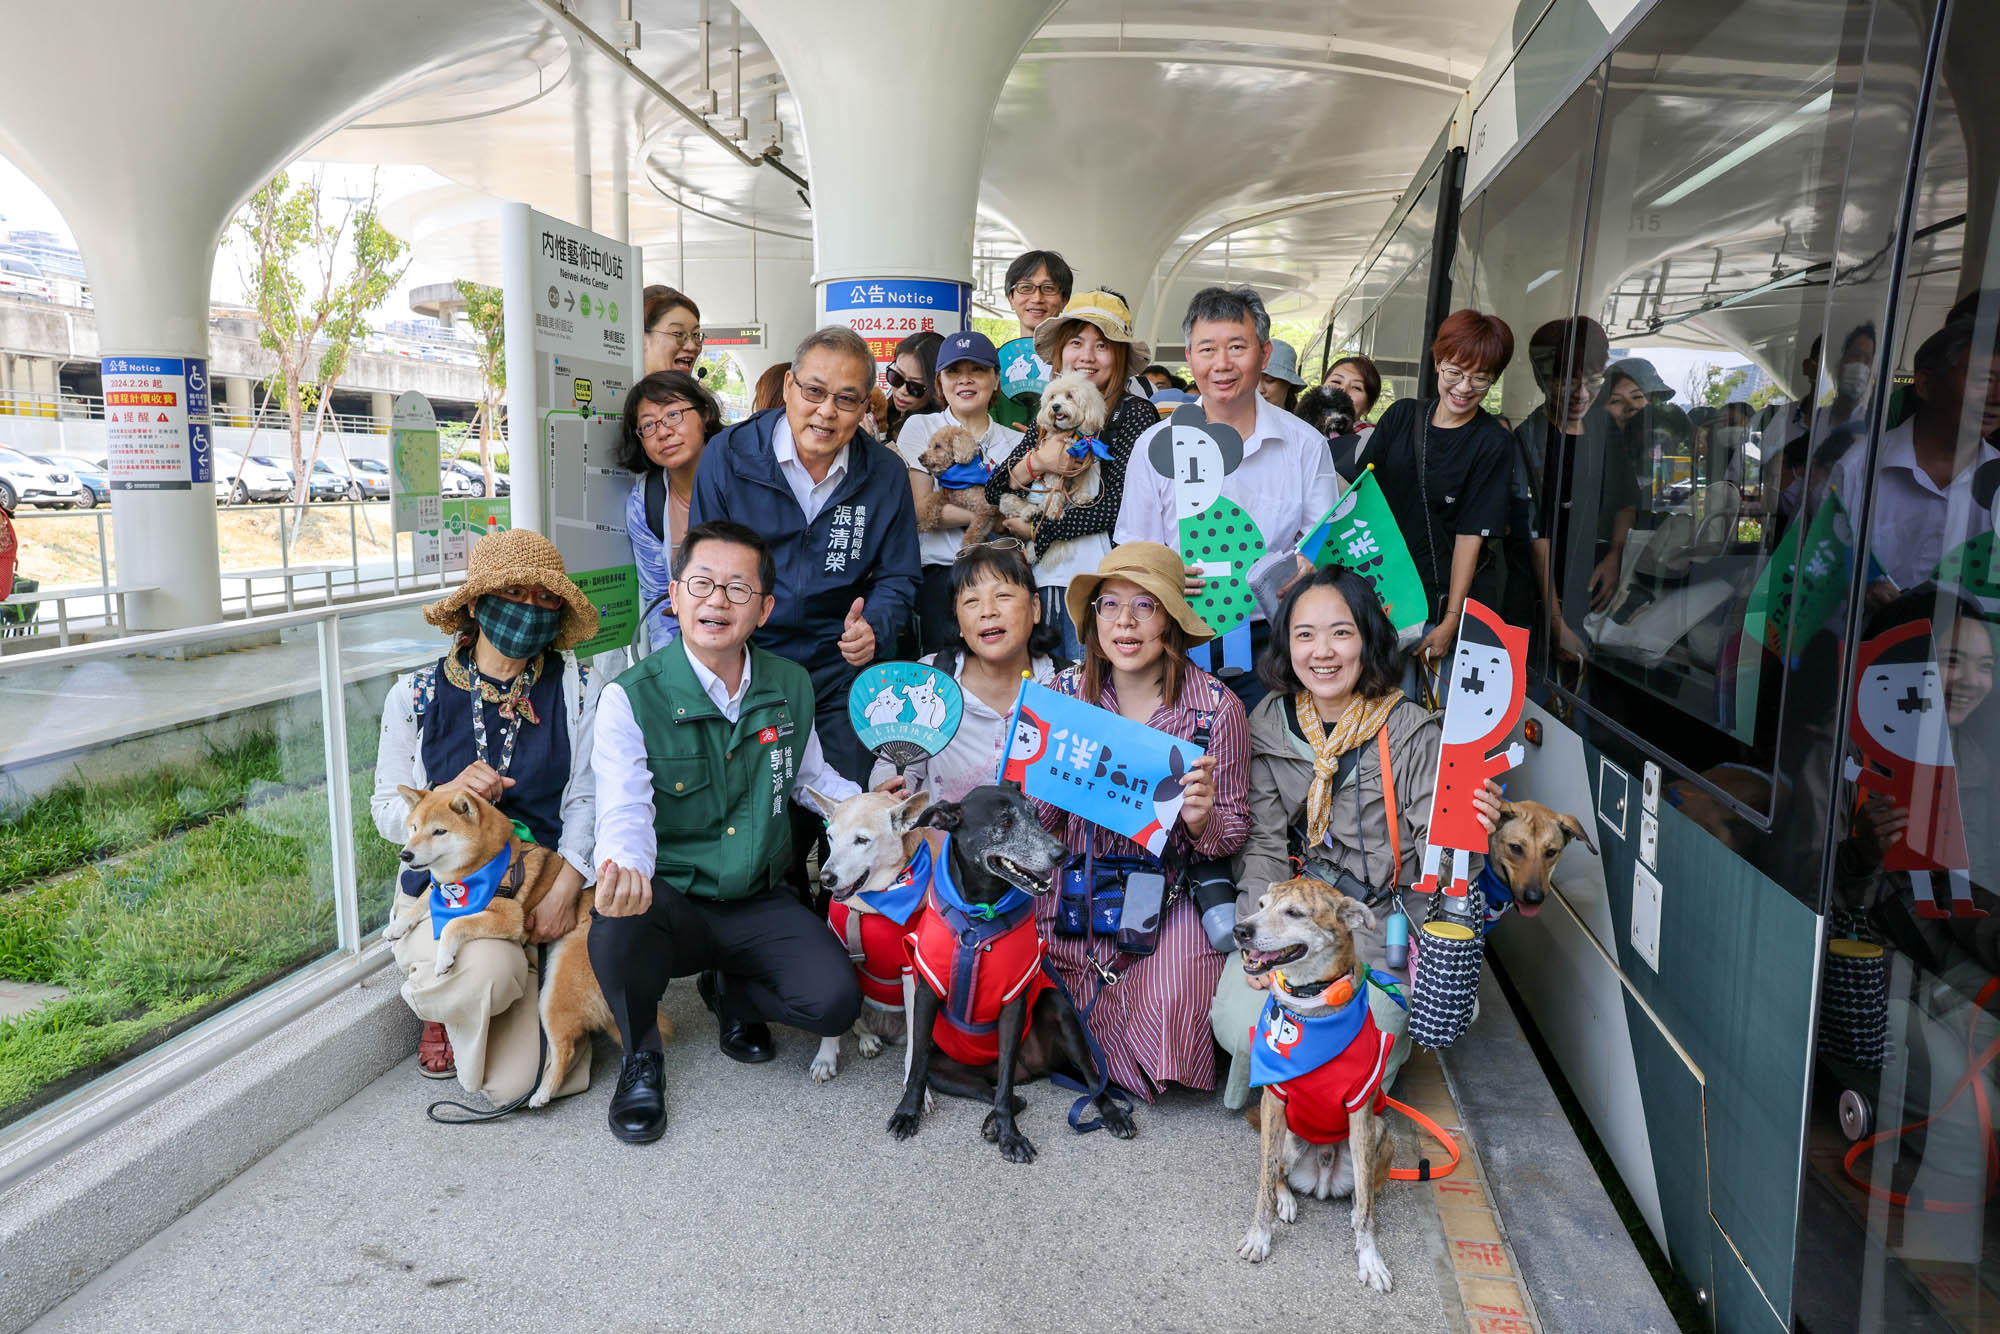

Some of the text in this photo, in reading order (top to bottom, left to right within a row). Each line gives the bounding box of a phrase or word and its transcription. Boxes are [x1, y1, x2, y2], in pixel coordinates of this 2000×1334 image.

[560, 268, 608, 290] Neiwei Arts Center
[850, 284, 934, 304] 公告 Notice
[850, 316, 935, 332] 2024.2.26 起
[110, 360, 161, 372] 公告 Notice
[111, 379, 163, 389] 2024.2.26 起
[824, 505, 852, 572] 張清榮
[850, 505, 866, 560] 農業局局長
[1052, 729, 1098, 770] 伴
[1050, 766, 1144, 810] BEST ONE
